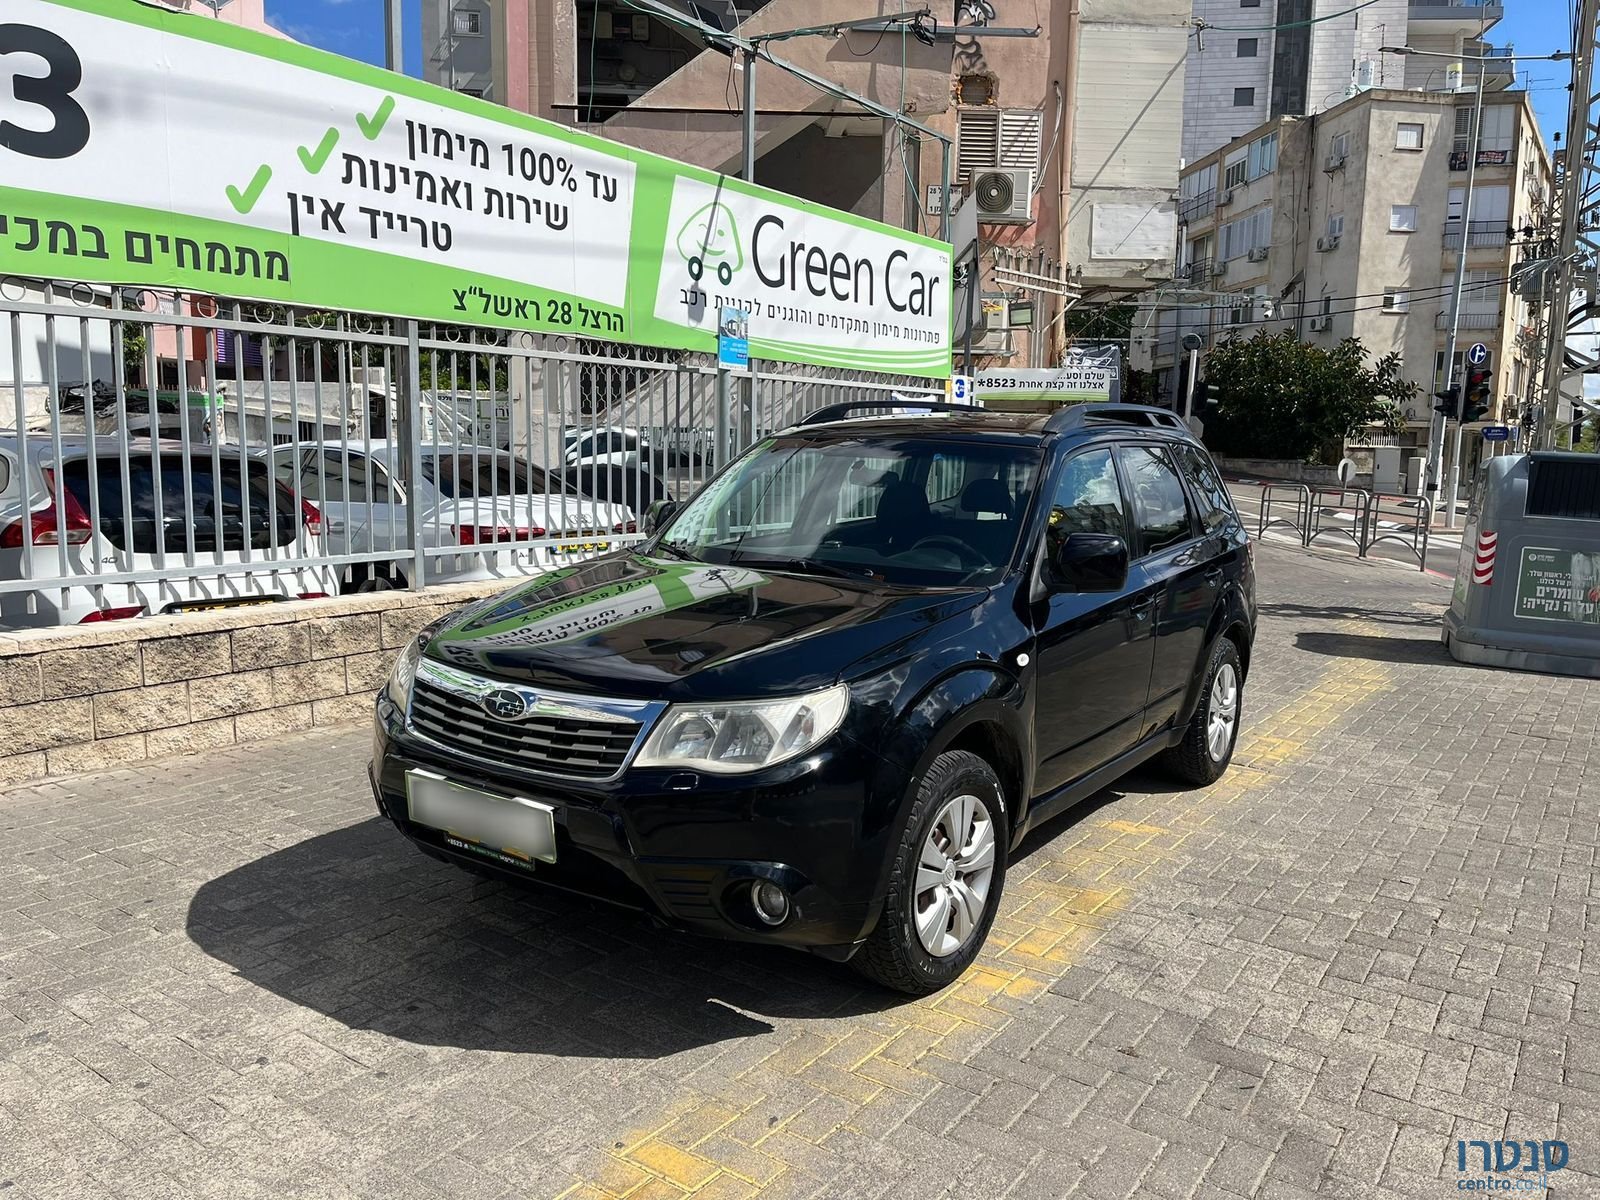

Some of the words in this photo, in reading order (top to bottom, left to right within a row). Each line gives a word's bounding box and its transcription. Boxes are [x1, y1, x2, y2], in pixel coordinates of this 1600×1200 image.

[406, 120, 489, 169] מימון
[502, 144, 577, 192] 100%
[342, 153, 473, 211] ואמינות
[585, 170, 617, 202] עד
[288, 192, 346, 236] אין
[484, 187, 567, 230] שירות
[359, 207, 452, 252] טרייד
[124, 231, 289, 281] מתמחים
[752, 215, 873, 306] Green
[885, 249, 939, 317] Car
[453, 286, 540, 320] ראשל"צ
[680, 288, 707, 308] רכב
[547, 300, 572, 325] 28
[578, 303, 624, 332] הרצל
[768, 304, 812, 324] והוגנים
[818, 313, 869, 335] מתקדמים
[873, 322, 900, 338] מימון
[903, 327, 940, 344] פתרונות
[1045, 382, 1065, 391] קצת
[1066, 381, 1077, 389] זה
[1079, 380, 1104, 389] אצלנו
[1084, 371, 1105, 380] שלם
[1523, 597, 1561, 612] נקייה!
[1536, 586, 1585, 601] שומרים
